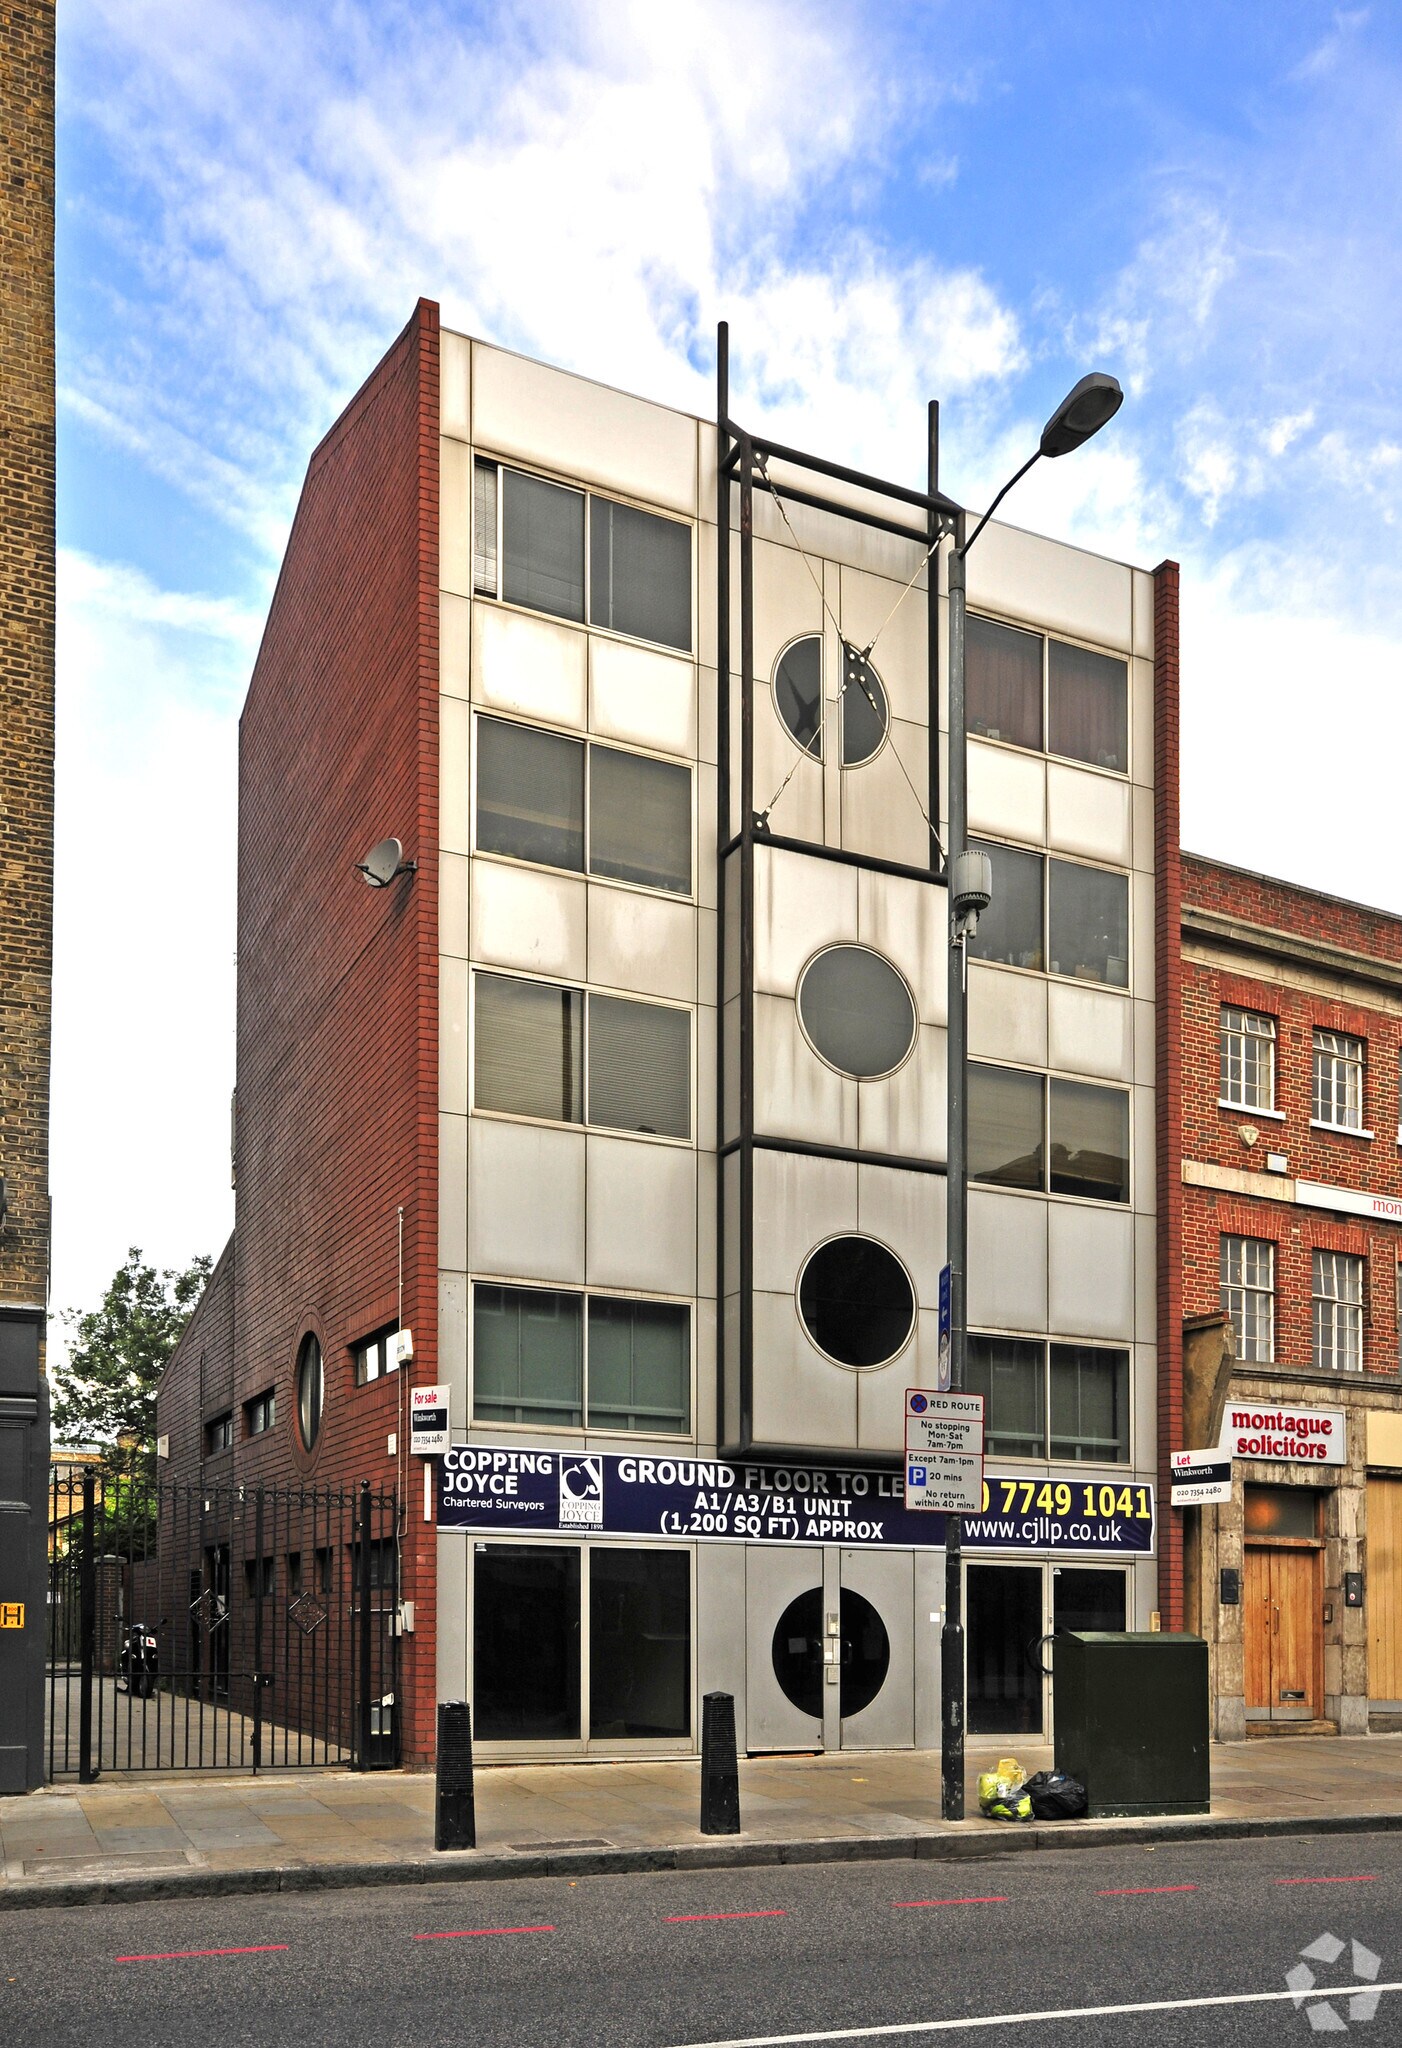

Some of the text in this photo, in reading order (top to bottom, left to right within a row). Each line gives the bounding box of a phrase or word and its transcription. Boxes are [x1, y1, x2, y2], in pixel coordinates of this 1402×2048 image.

[414, 1390, 437, 1404] For sale
[930, 1400, 980, 1411] RED ROUTE
[920, 1421, 970, 1432] No stopping
[1232, 1411, 1332, 1438] montague
[928, 1431, 963, 1440] Mon-Sat
[927, 1440, 963, 1450] 7am-7pm
[1237, 1435, 1328, 1459] solicitors
[443, 1450, 552, 1475] COPPING
[908, 1454, 974, 1466] Except 7am-1pm
[1176, 1454, 1191, 1466] Let
[913, 1468, 924, 1485] P
[929, 1472, 962, 1482] 20 mins
[1173, 1465, 1213, 1477] Winkworth
[443, 1472, 518, 1495] JOYCE
[617, 1458, 905, 1498] GROUND FLOOR TO LE
[925, 1490, 965, 1499] No return
[1190, 1488, 1204, 1497] 7354
[1205, 1485, 1222, 1495] 2480
[443, 1497, 545, 1512] Chartered Surveyors
[561, 1501, 601, 1511] COPPING
[694, 1491, 852, 1517] A1/A3/B1 UNIT
[914, 1499, 975, 1510] within 40 mins
[1000, 1481, 1072, 1516] 7749
[1083, 1484, 1151, 1519] 1041
[561, 1509, 600, 1521] JOYCE
[558, 1522, 589, 1530] Established
[660, 1509, 884, 1540] (1,200 SQ FT) APPROX
[964, 1516, 1122, 1545] www.cjllp.co.uk
[148, 1638, 155, 1646] L
